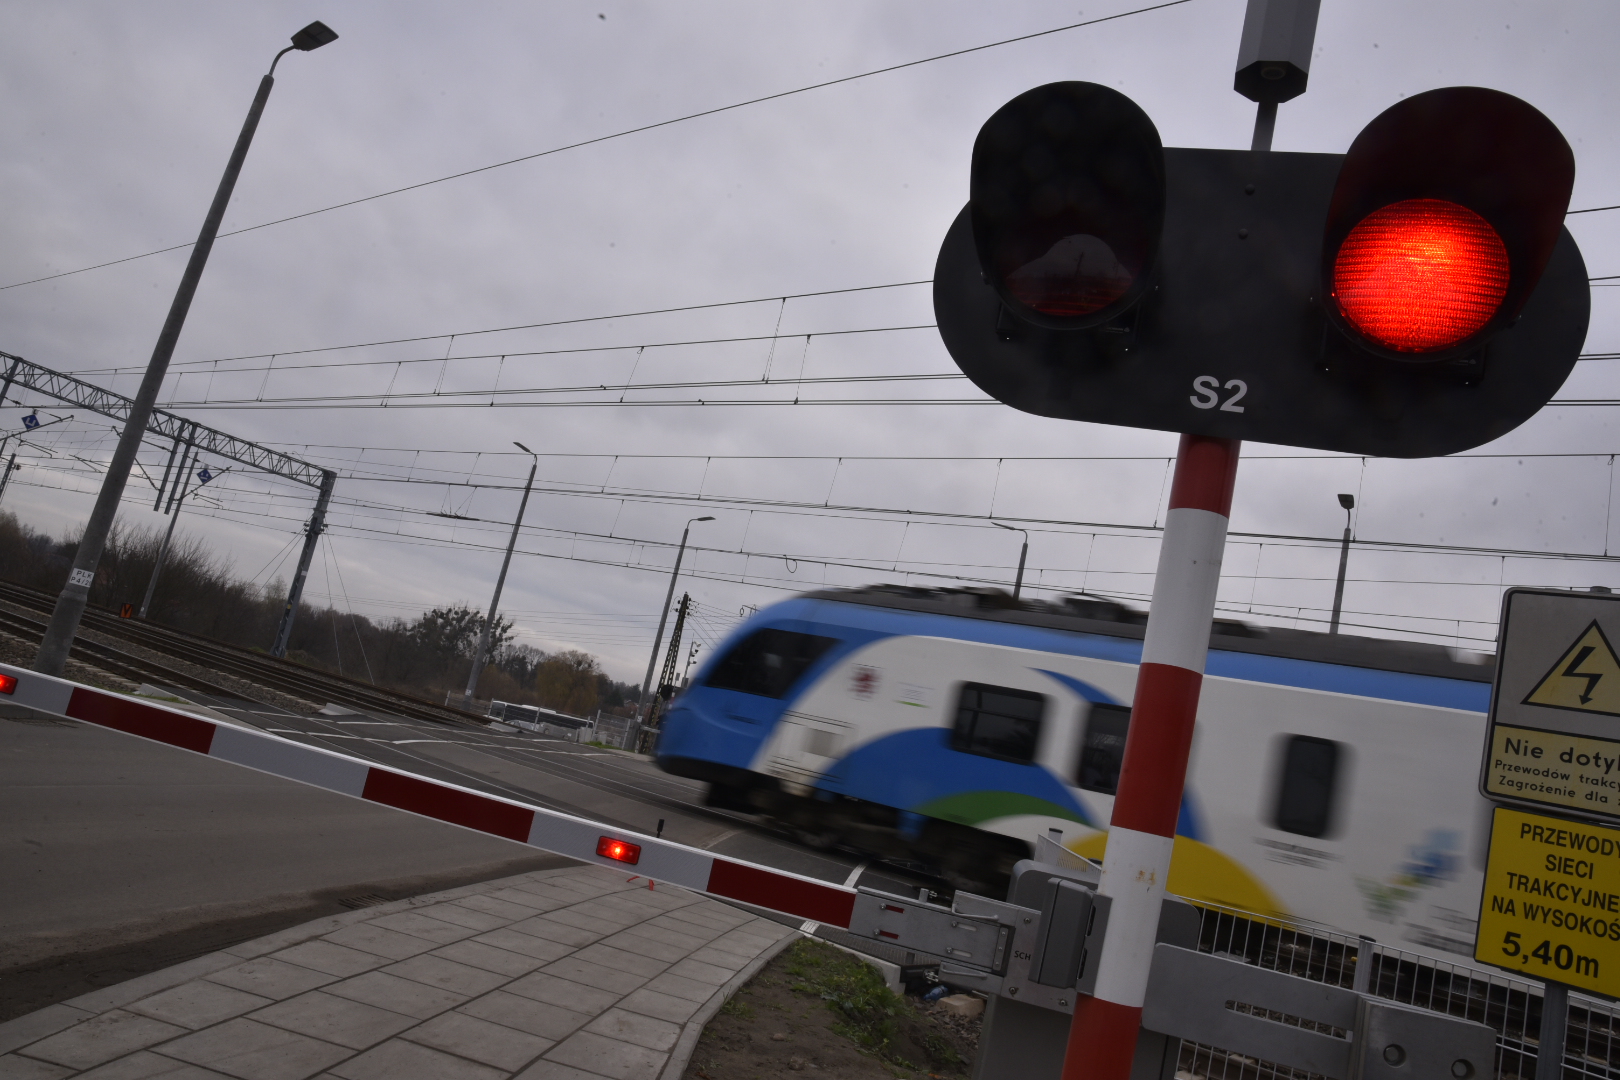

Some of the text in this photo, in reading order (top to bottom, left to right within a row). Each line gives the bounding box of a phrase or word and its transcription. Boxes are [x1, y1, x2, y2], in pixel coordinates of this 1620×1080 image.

[1189, 375, 1248, 414] S2
[76, 570, 92, 579] PLK
[1494, 759, 1571, 781] Przewodów
[1504, 737, 1620, 775] Nie doty
[1498, 775, 1576, 798] Zagrożenie
[1584, 790, 1609, 804] dla
[1545, 853, 1594, 880] SIECI
[1506, 871, 1620, 914] TRAKCYJNE
[1491, 894, 1620, 942] NA WYSOKOŚ
[1014, 950, 1031, 961] SCH
[1501, 930, 1600, 979] 5,40m
